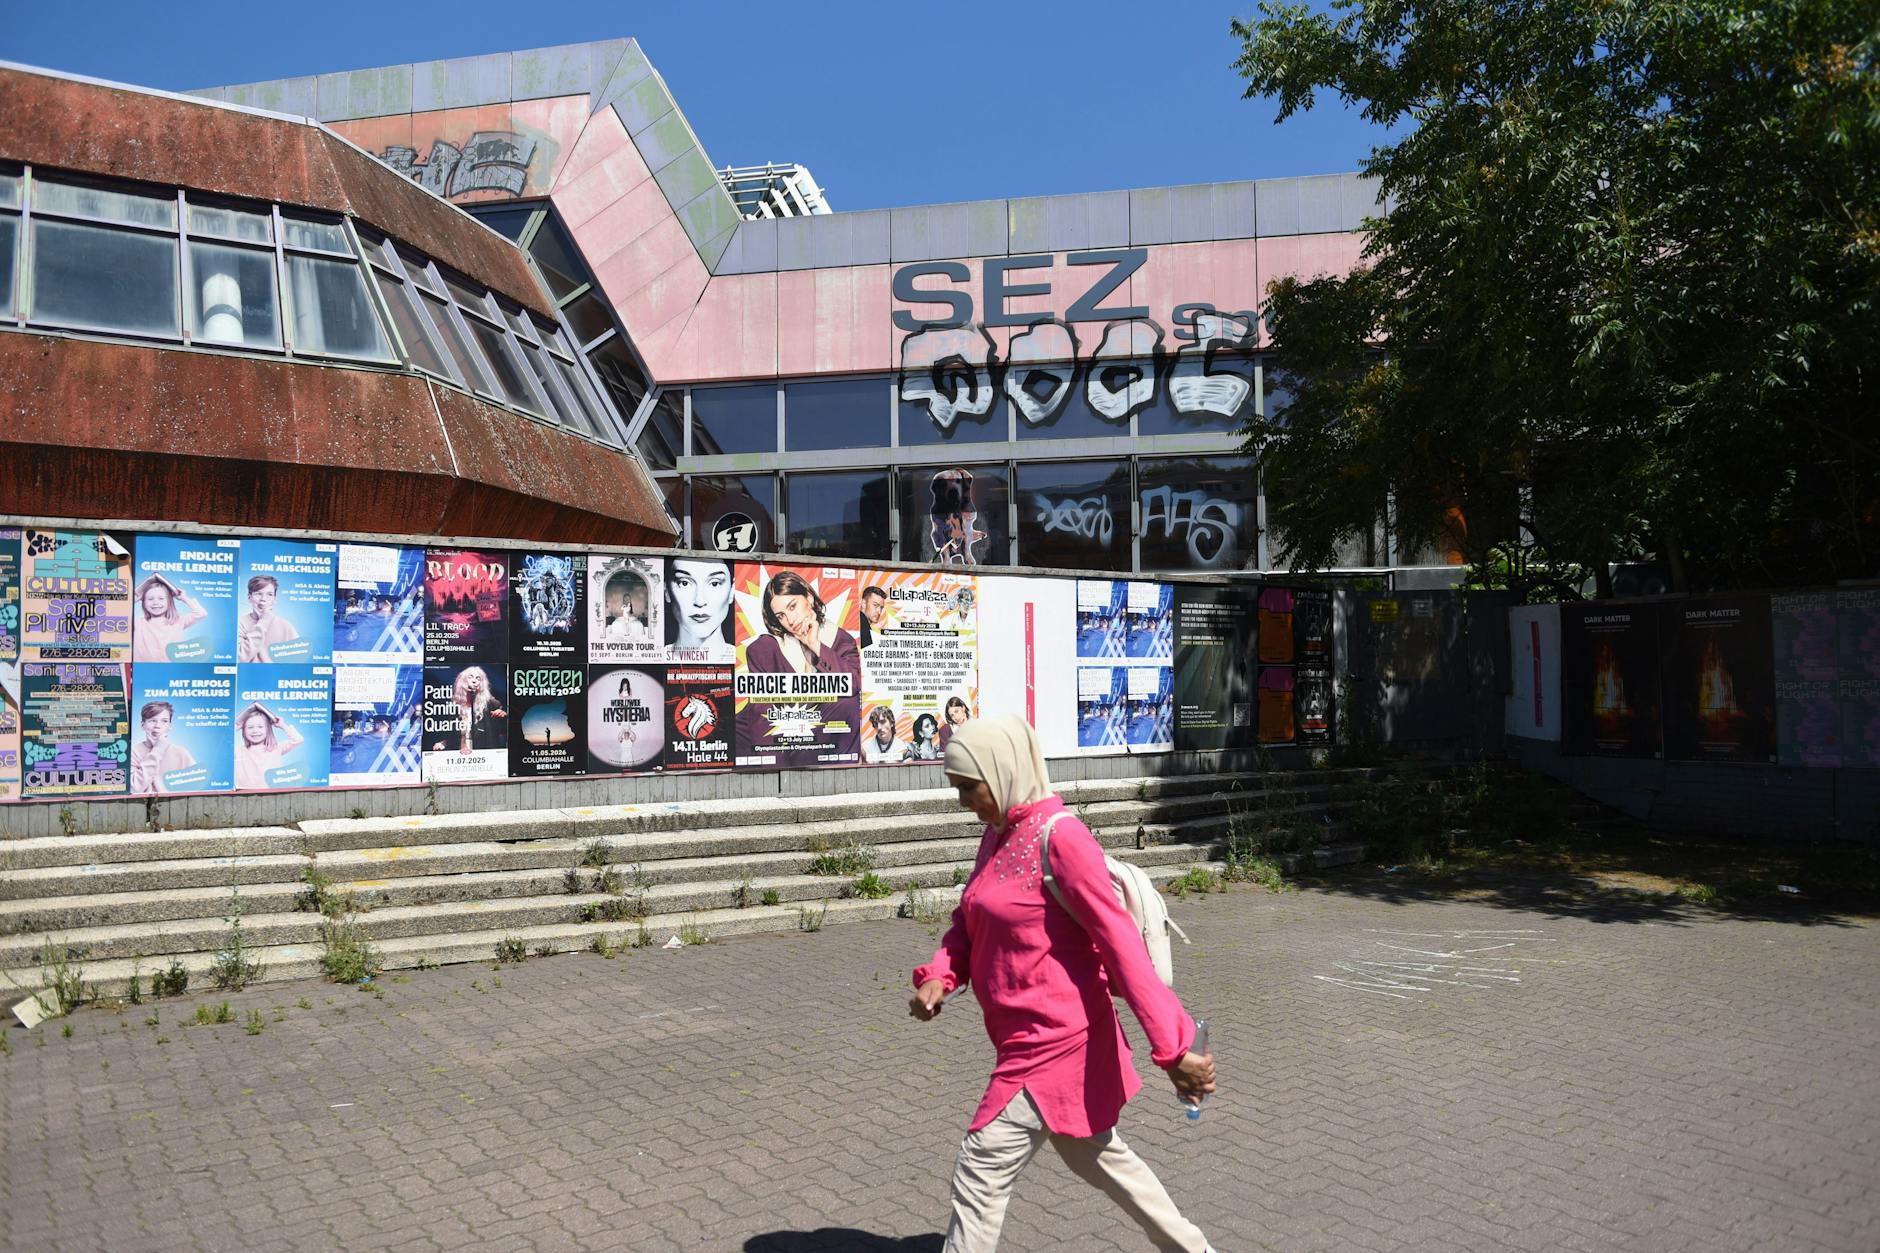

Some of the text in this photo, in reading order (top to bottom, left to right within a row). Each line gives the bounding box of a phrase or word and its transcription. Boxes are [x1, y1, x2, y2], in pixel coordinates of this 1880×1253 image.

[893, 248, 1149, 332] SEZ
[180, 551, 234, 562] ENDLICH
[274, 555, 332, 565] MIT ERFOLG
[141, 561, 233, 574] GERNE LERNEN
[251, 564, 331, 574] ZUM ABSCHLUSS
[426, 560, 505, 582] BLOOD
[28, 577, 127, 594] CULTURES
[48, 597, 106, 617] Sonic
[1710, 609, 1740, 617] MATTER
[25, 613, 128, 633] Pluriverse
[426, 622, 470, 631] LIL TRACY
[55, 633, 99, 642] Festival
[879, 640, 898, 648] JUSTIN
[900, 640, 934, 649] TIMBERLAKE
[666, 650, 709, 661] ST. VINCENT
[886, 651, 909, 659] ABRAMS
[24, 664, 63, 677] Sonic
[170, 680, 230, 688] MIT ERFOLG
[278, 680, 328, 689] ENDLICH
[737, 676, 786, 694] GRACIE
[792, 675, 848, 694] ABRAMS
[144, 689, 230, 698] ZUM ABSCHLUSS
[242, 691, 328, 700] GERNE LERNEN
[424, 685, 453, 699] Patti
[514, 686, 581, 696] OFFLINE 2026
[424, 701, 460, 716] Smith
[604, 707, 650, 722] HYSTERIA
[424, 717, 470, 732] Quarte
[672, 740, 728, 752] 14.11. Berlin
[446, 756, 486, 764] 11.07.2025
[687, 752, 728, 762] Hole 44
[25, 770, 125, 787] CULTURES
